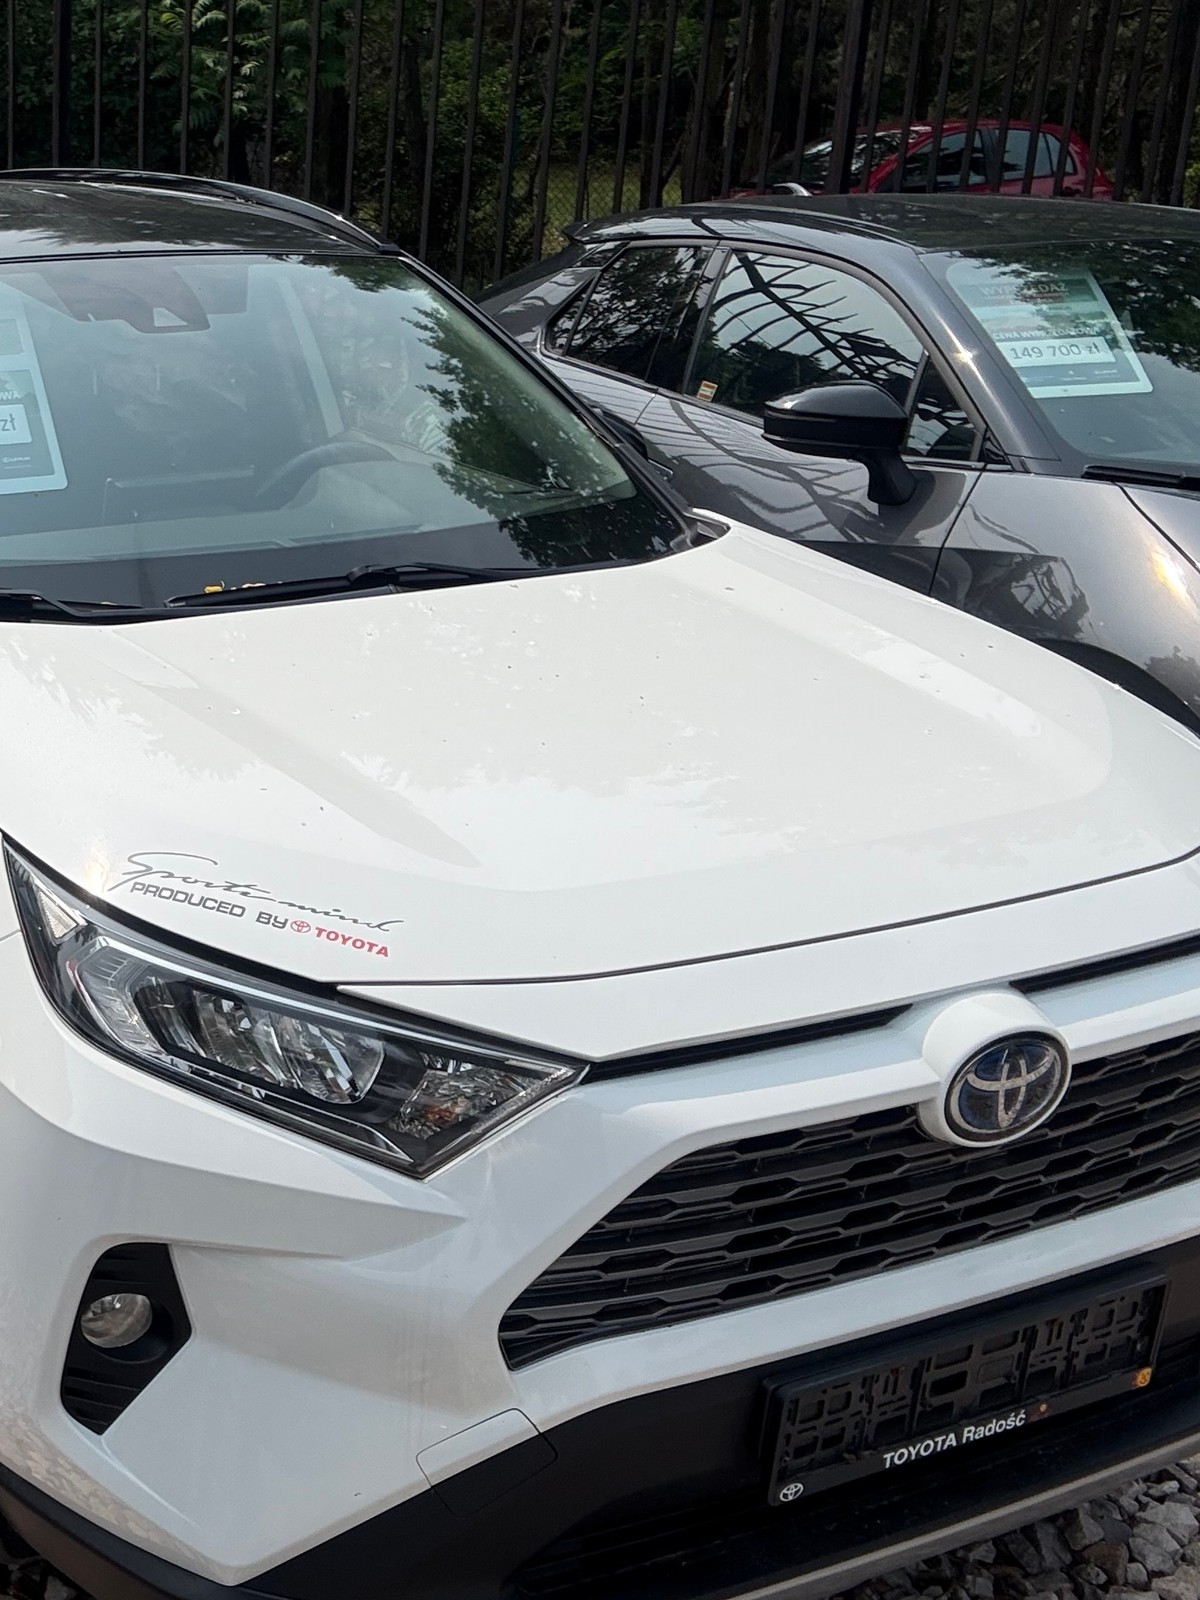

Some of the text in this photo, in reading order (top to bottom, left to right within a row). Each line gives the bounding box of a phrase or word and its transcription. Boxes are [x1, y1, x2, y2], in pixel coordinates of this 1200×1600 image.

[1011, 345, 1044, 360] 149
[1047, 343, 1082, 358] 700
[0, 413, 17, 432] zł
[130, 881, 390, 958] PRODUCED BY TOYOTA
[883, 1409, 1026, 1469] TOYOTA Radość
